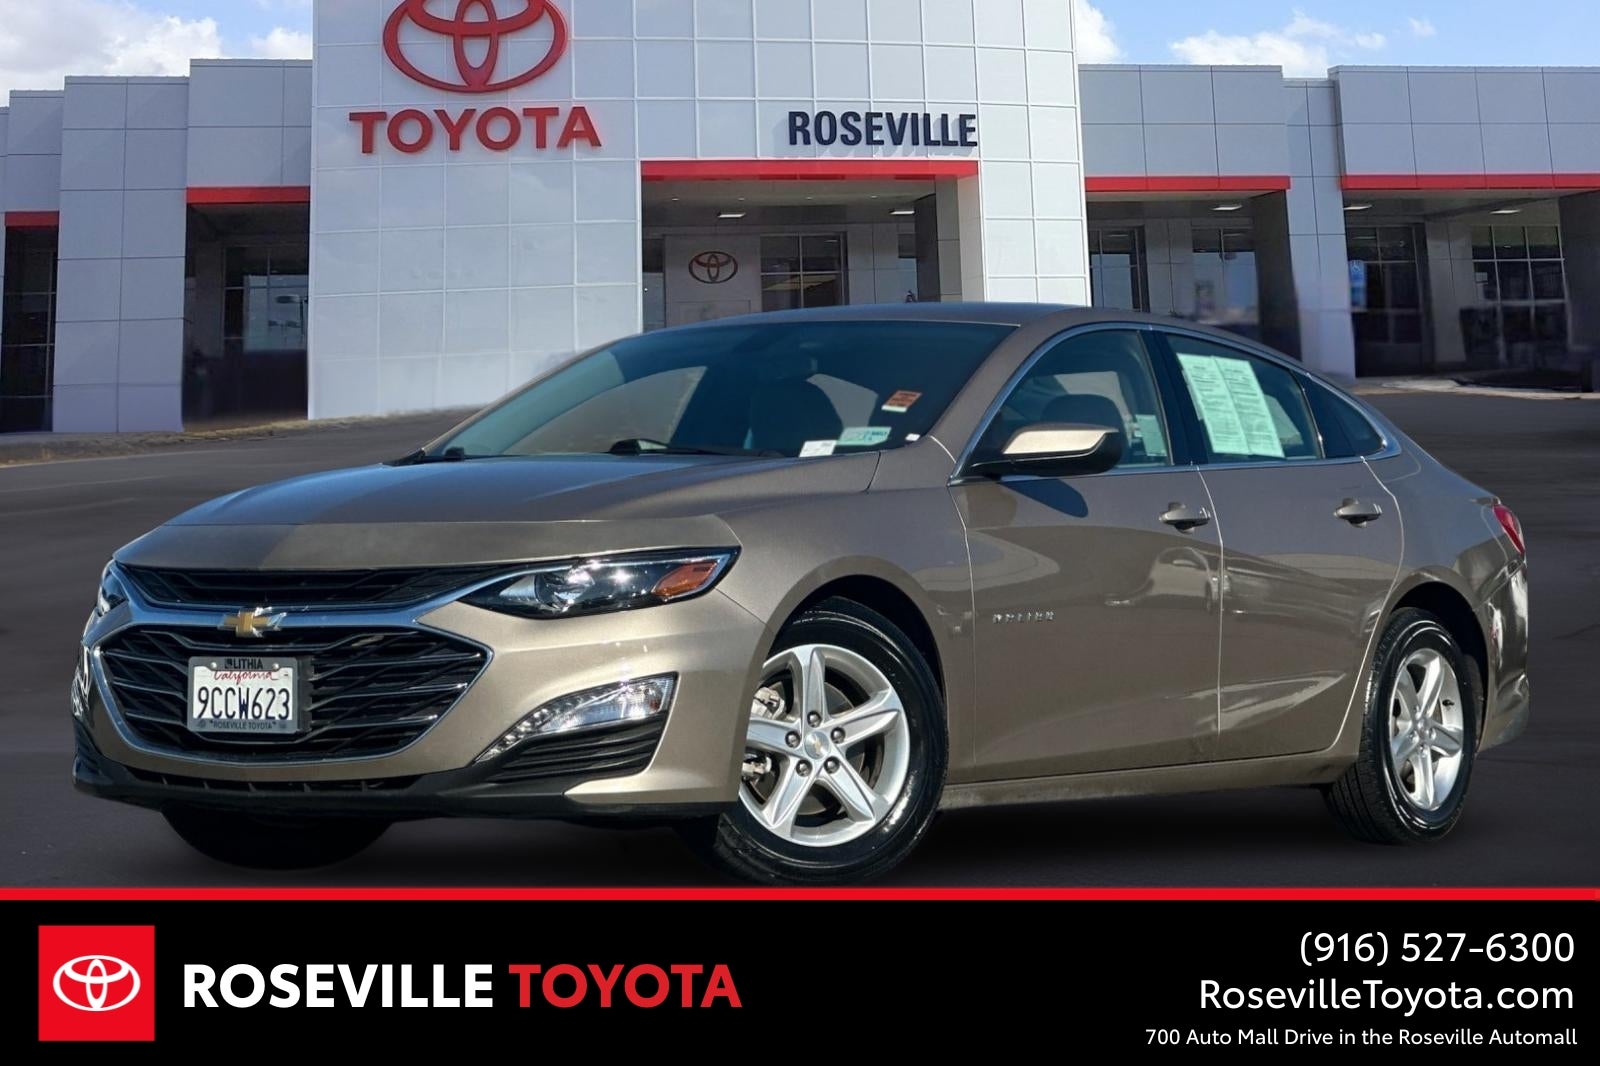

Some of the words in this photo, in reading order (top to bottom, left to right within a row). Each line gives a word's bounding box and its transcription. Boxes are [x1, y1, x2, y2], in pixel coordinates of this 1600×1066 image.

[349, 106, 602, 154] TOYOTA
[788, 110, 978, 147] ROSEVILLE
[233, 658, 264, 669] LITHIA
[197, 686, 290, 720] 9CCW623
[248, 721, 273, 730] TOYOTA
